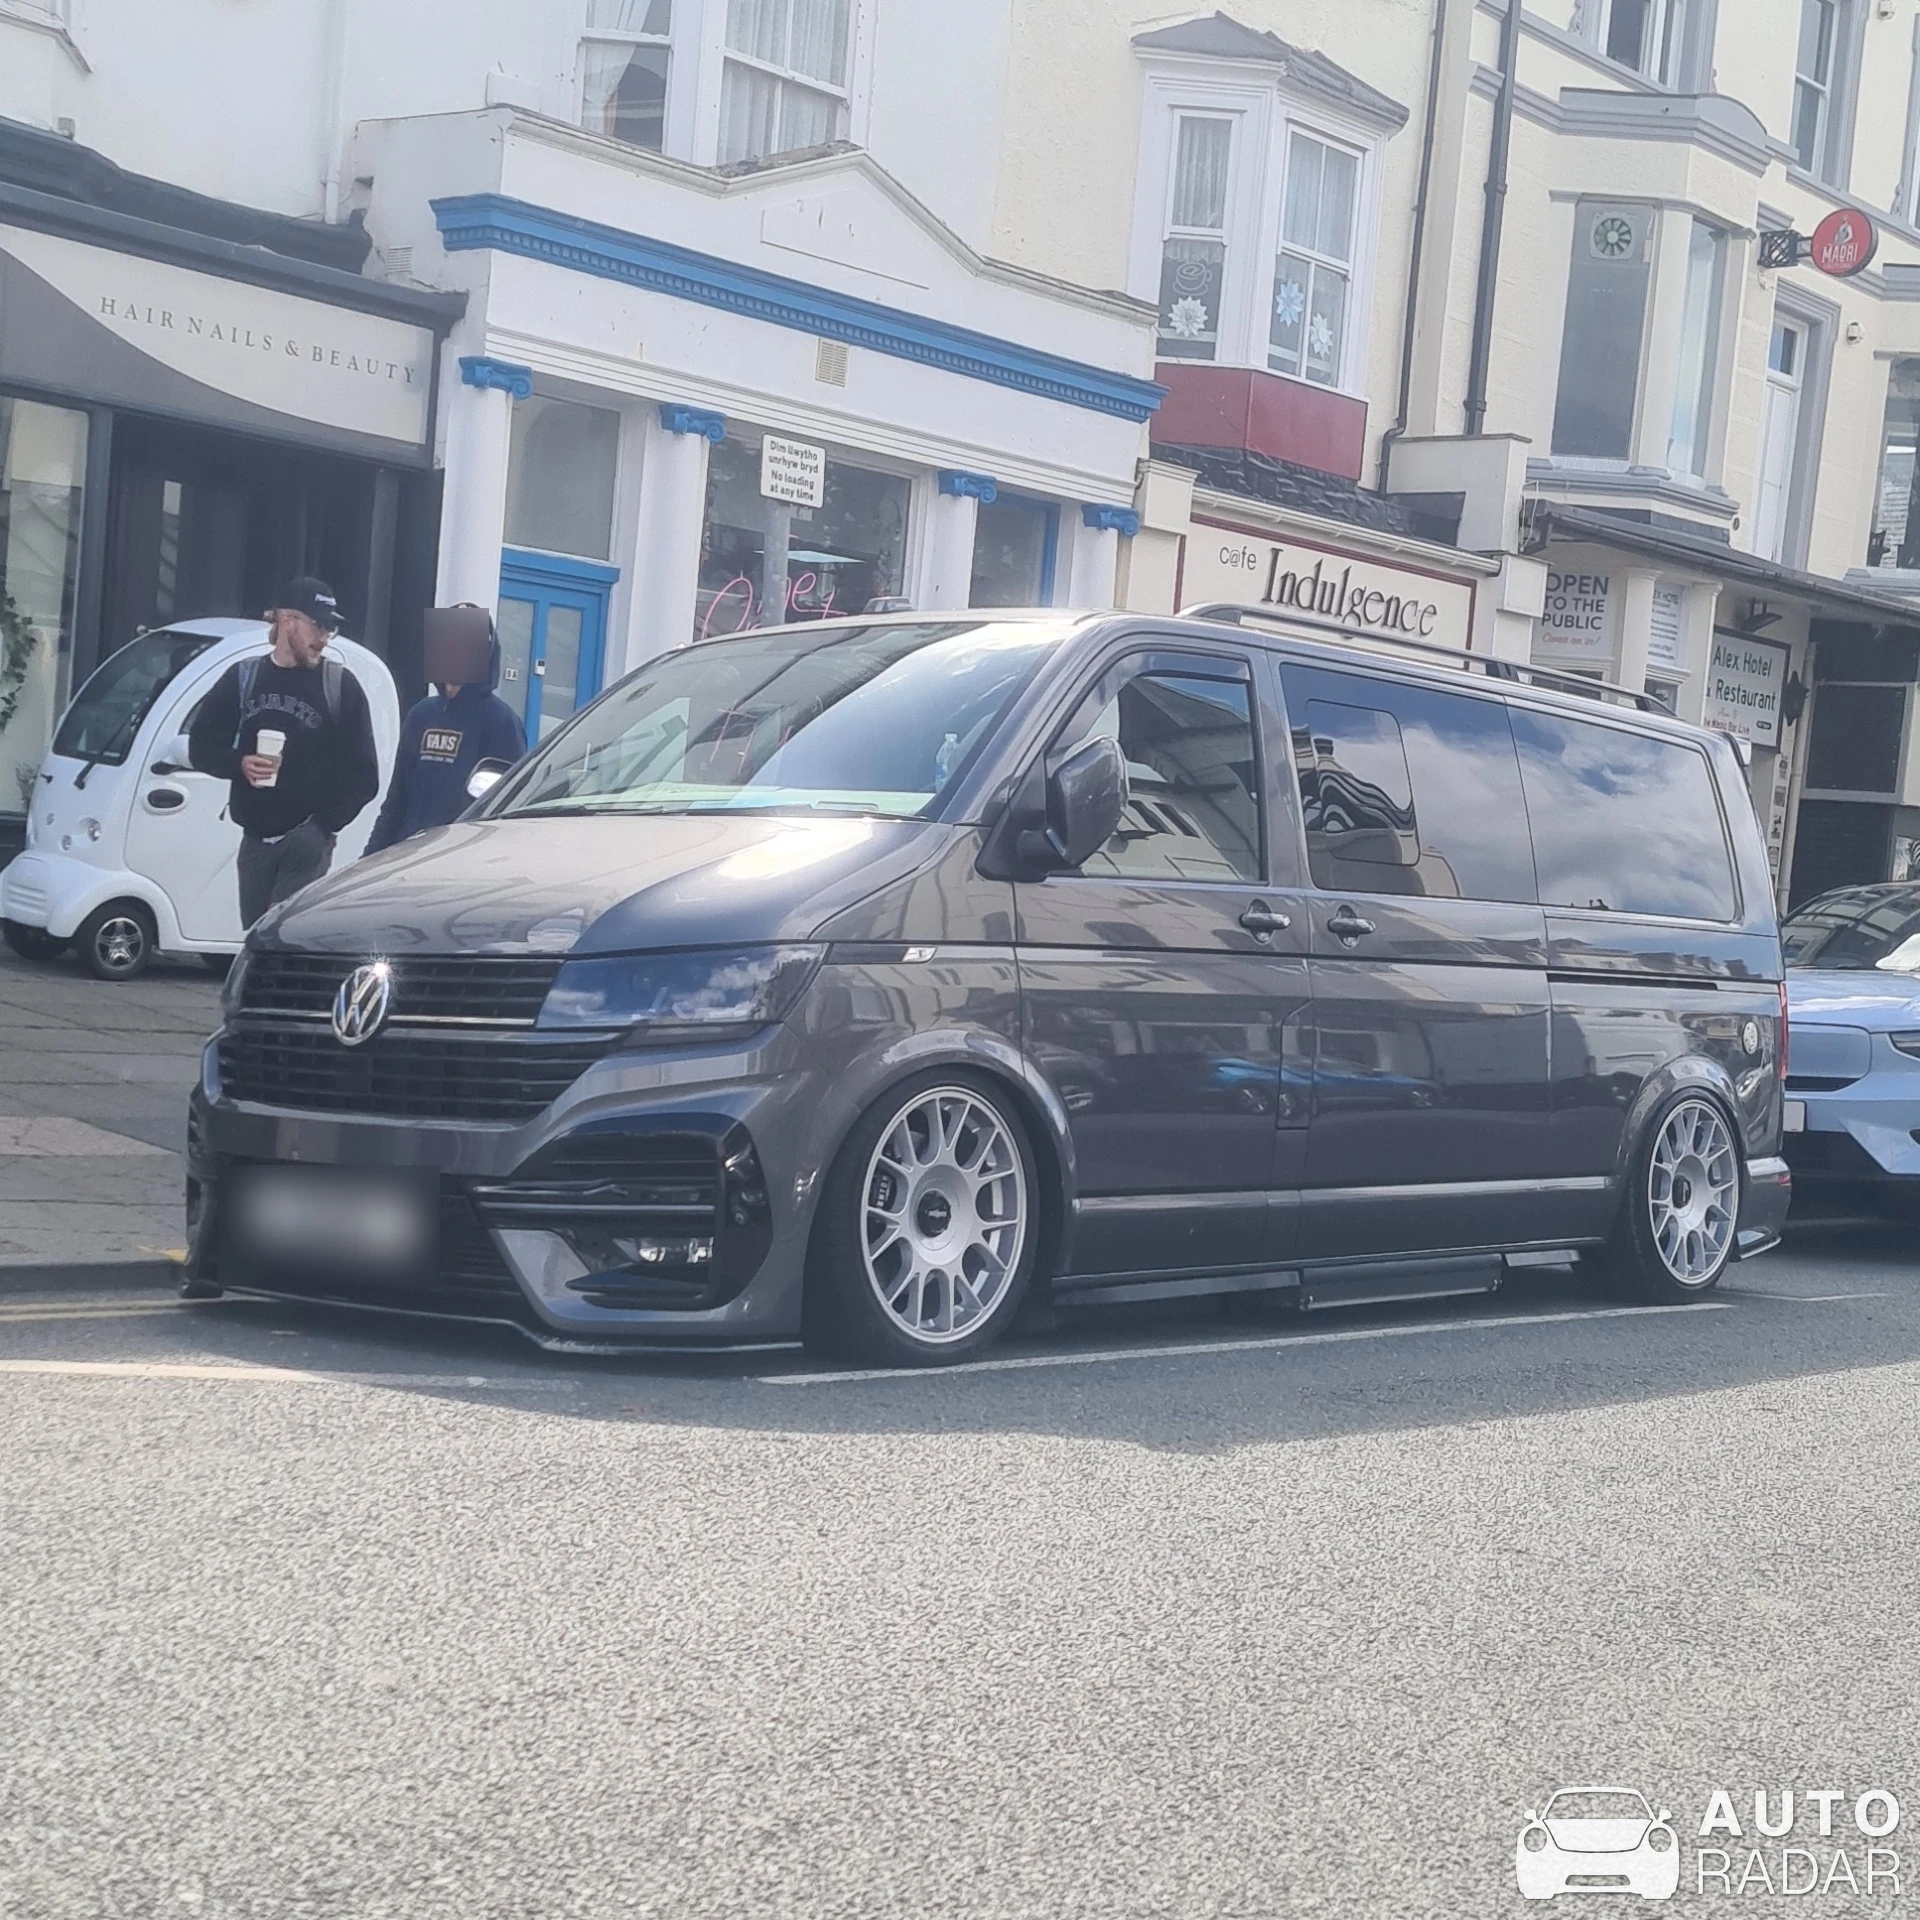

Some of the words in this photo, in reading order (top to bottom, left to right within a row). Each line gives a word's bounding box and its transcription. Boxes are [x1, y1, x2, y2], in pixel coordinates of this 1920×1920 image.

[99, 296, 175, 329] HAIR
[187, 316, 273, 351] NAILS
[285, 339, 300, 357] &
[311, 345, 415, 384] BEAUTY
[770, 440, 786, 453] Dim
[787, 444, 818, 461] llwytho
[768, 455, 799, 469] unrhyw
[800, 460, 819, 474] bryd
[771, 469, 783, 482] No
[784, 473, 815, 490] loading
[770, 483, 778, 493] at
[780, 487, 794, 498] any
[797, 488, 814, 501] time
[1260, 547, 1438, 640] Indulgence
[1546, 573, 1610, 596] OPEN
[1544, 595, 1567, 611] TO
[1572, 597, 1605, 613] THE
[1541, 613, 1603, 630] PUBLIC
[1713, 645, 1739, 671] Alex
[1743, 651, 1773, 677] Hotel
[1715, 678, 1776, 711] Restaurant
[426, 733, 458, 751] VANS
